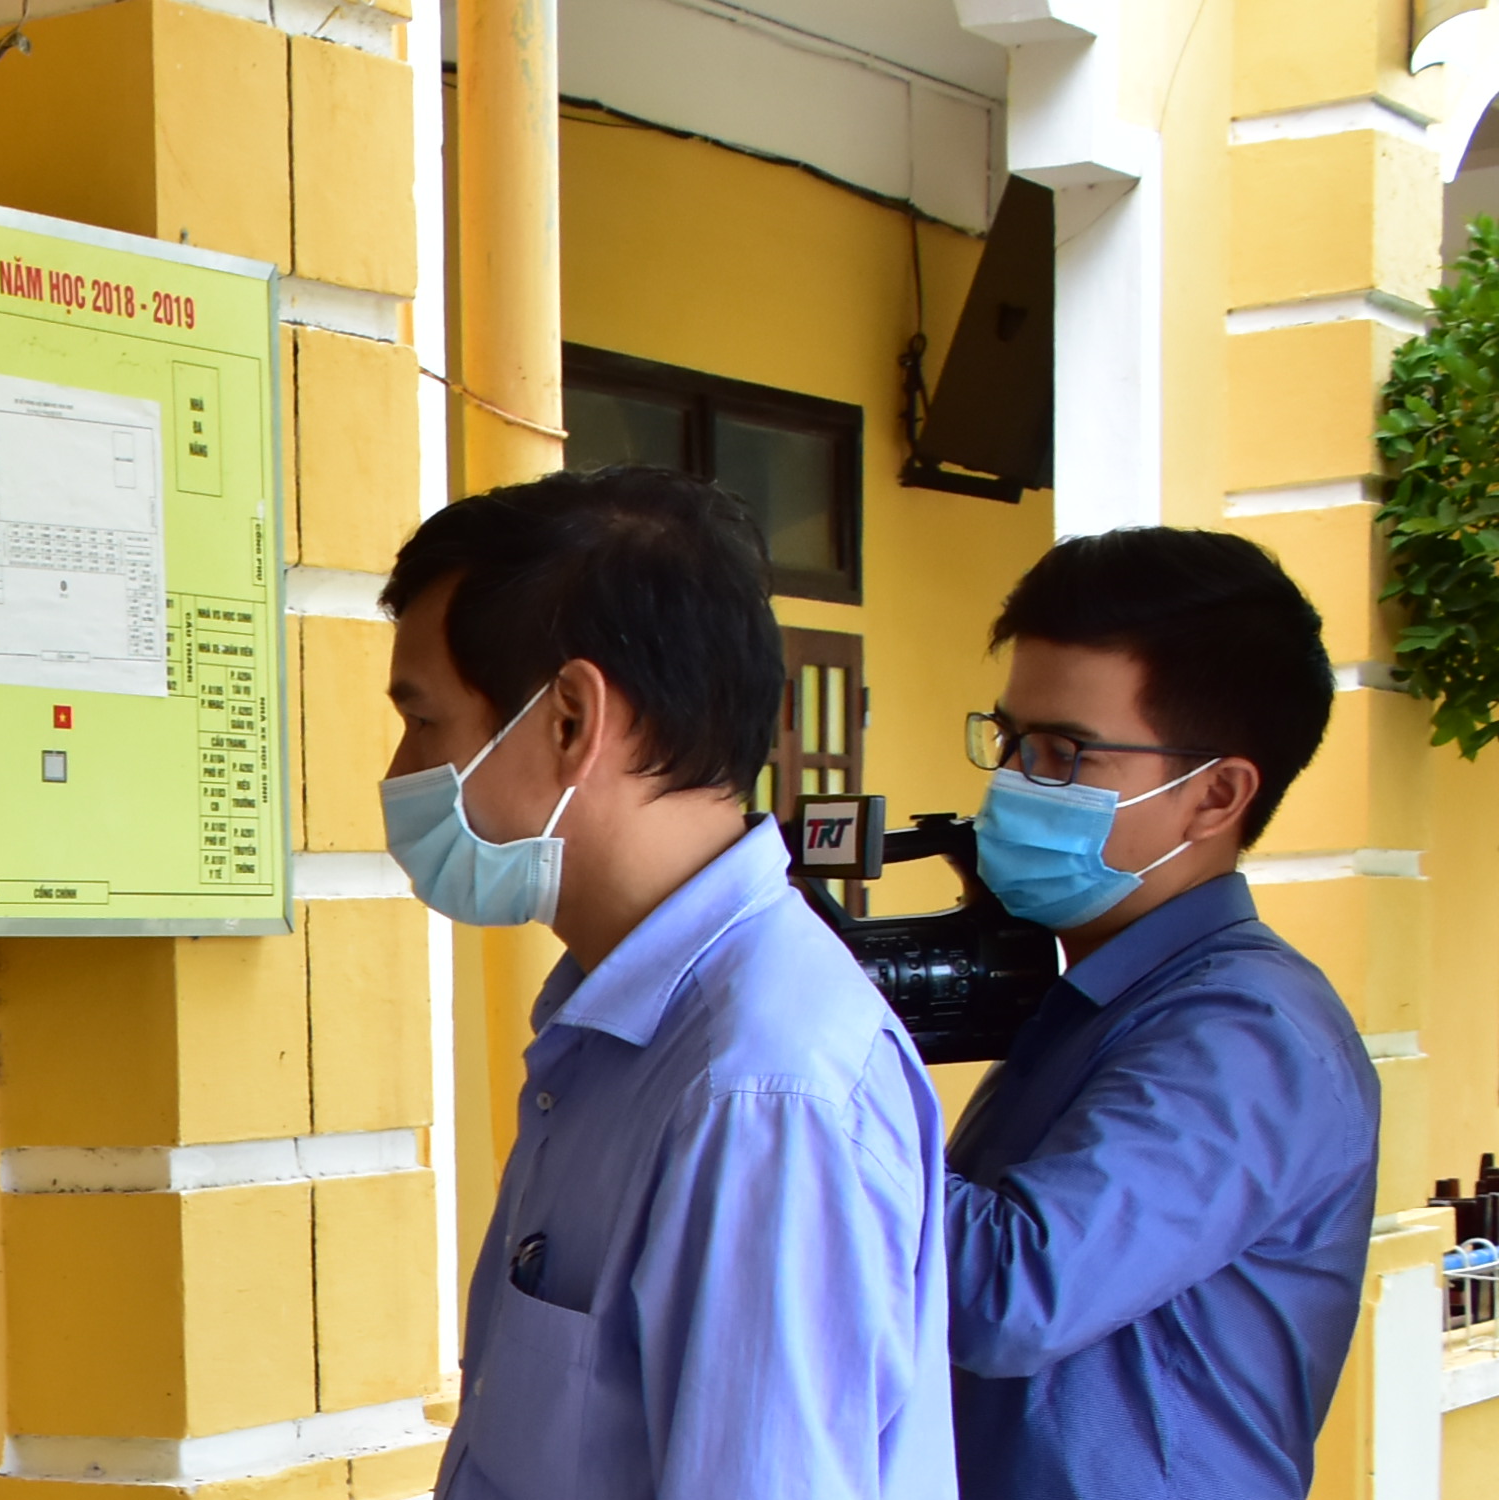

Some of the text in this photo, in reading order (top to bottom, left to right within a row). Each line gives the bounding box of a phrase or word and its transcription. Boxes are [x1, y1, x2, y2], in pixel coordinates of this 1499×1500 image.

[0, 256, 43, 301] NĂM
[49, 270, 86, 314] HỌC
[92, 280, 135, 318] 2018
[153, 291, 195, 329] 2019
[806, 818, 853, 849] TRT
